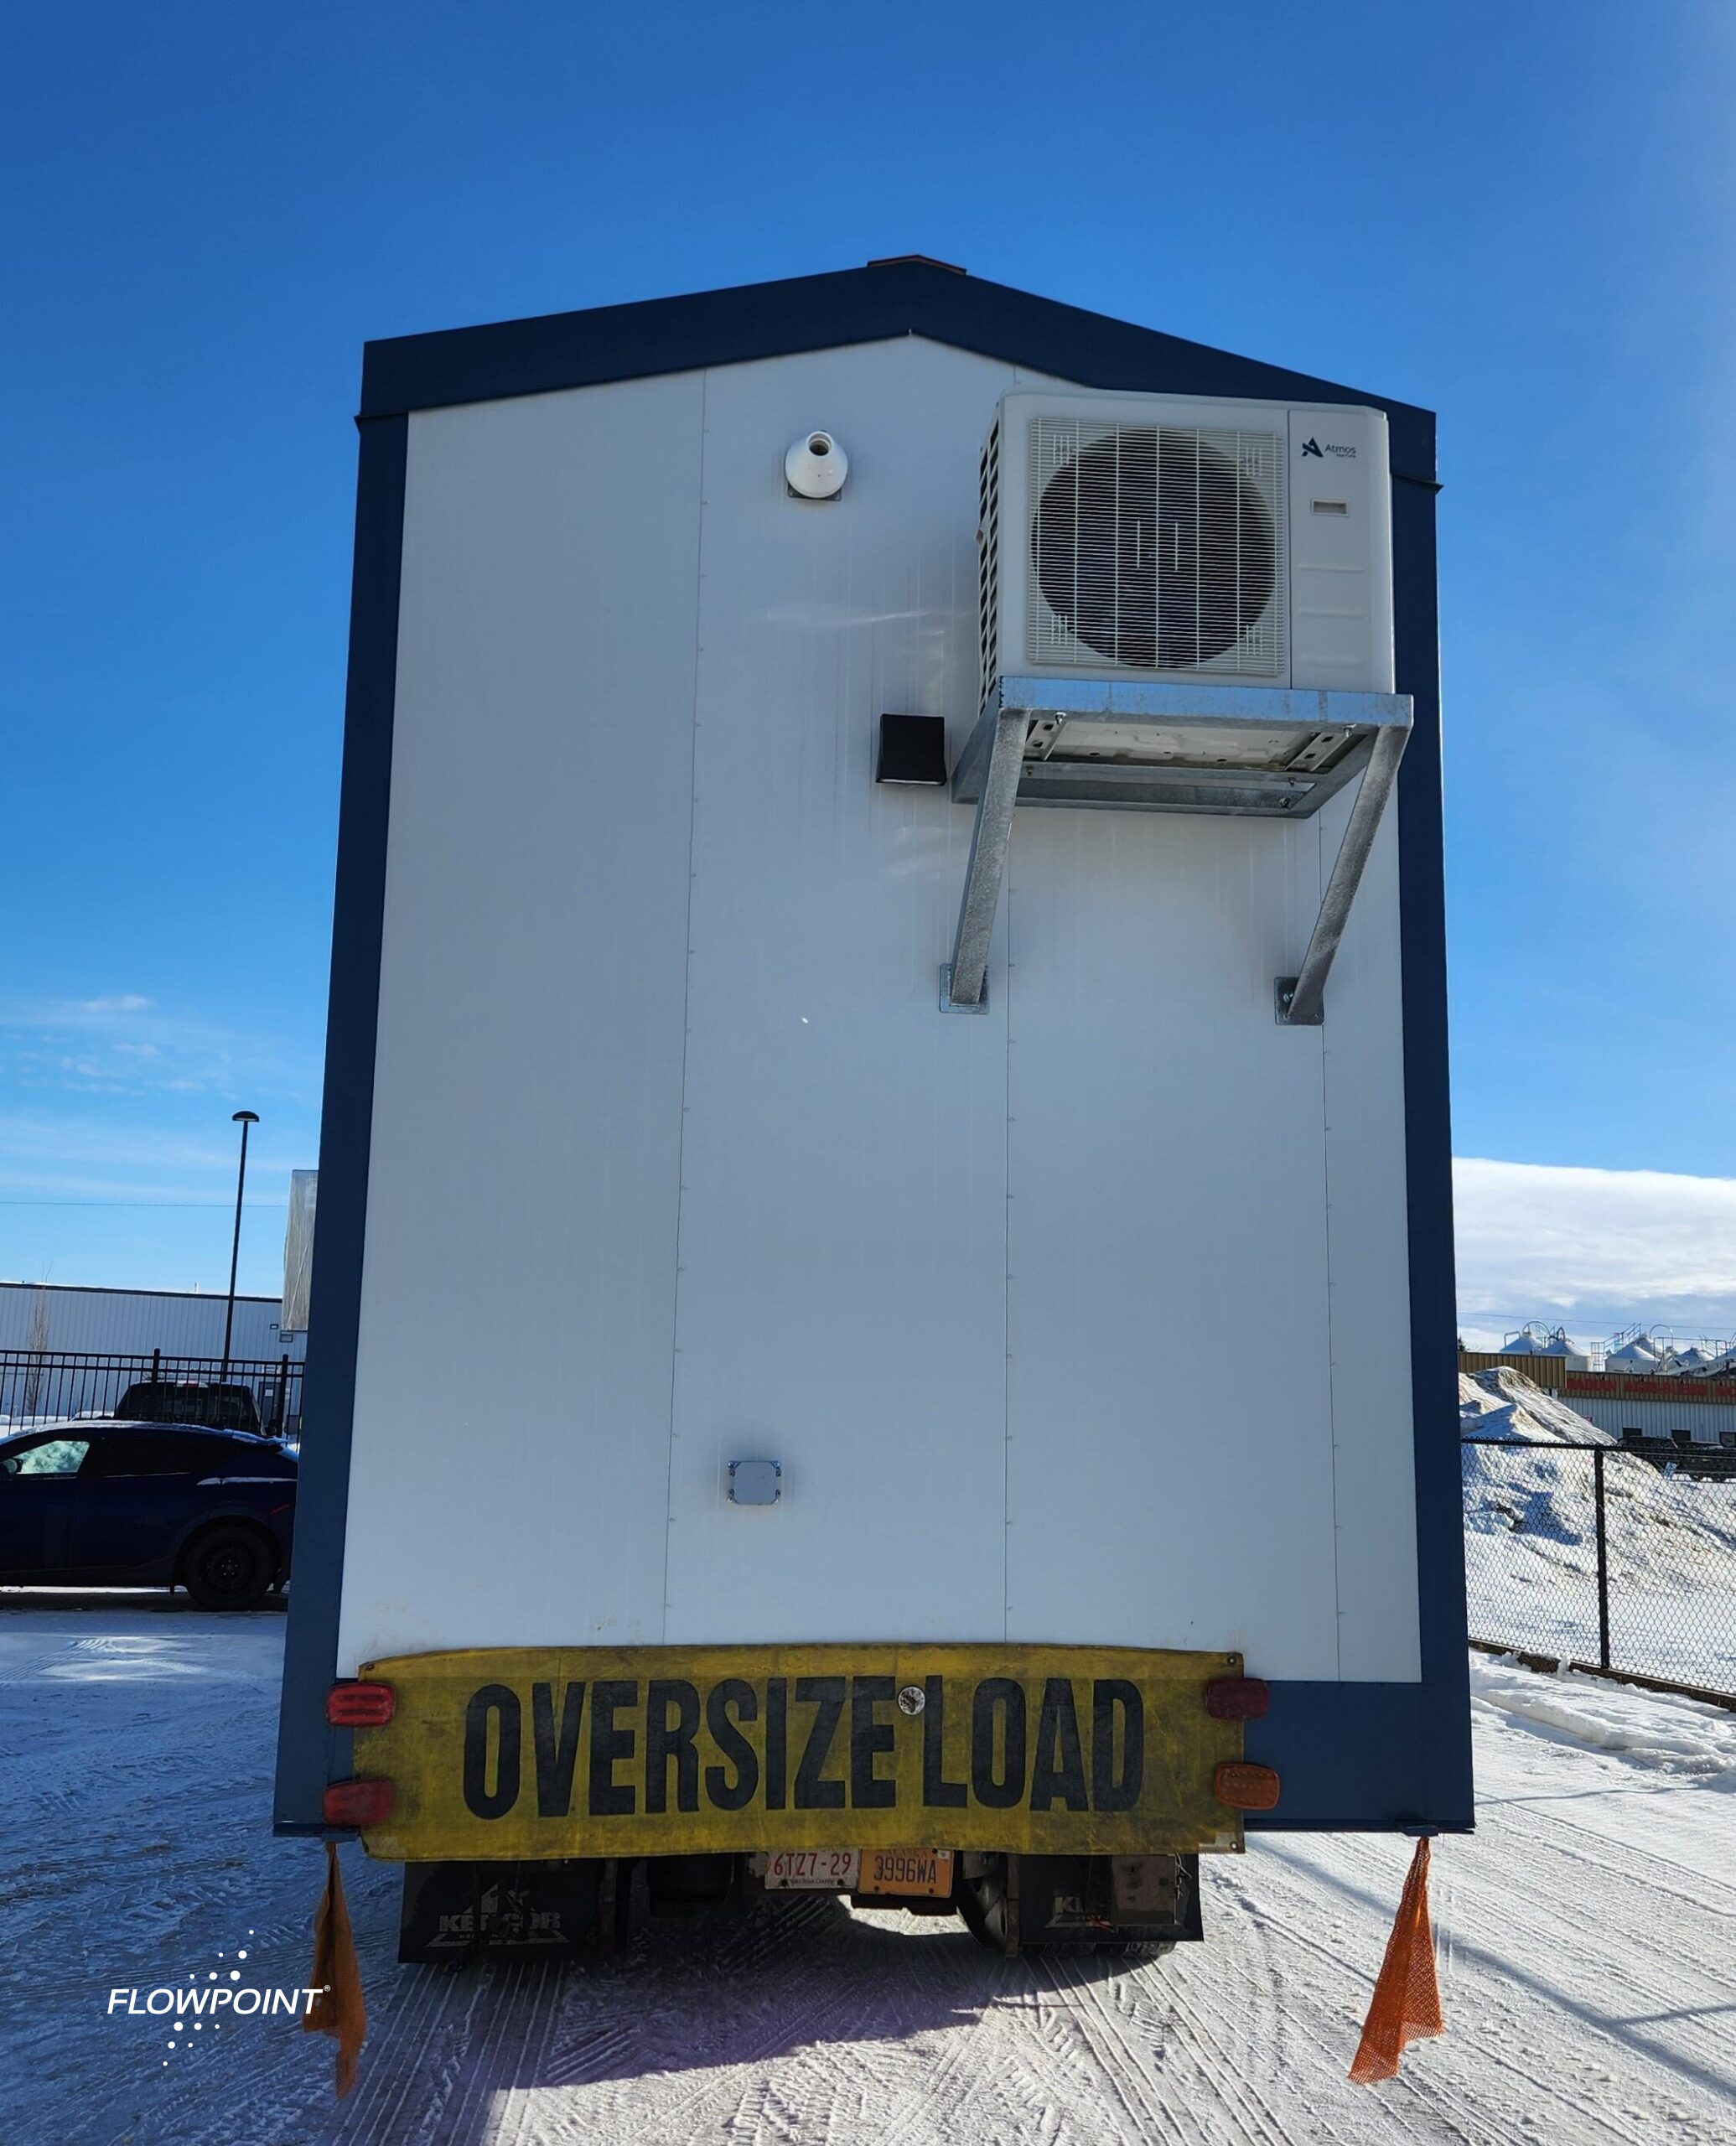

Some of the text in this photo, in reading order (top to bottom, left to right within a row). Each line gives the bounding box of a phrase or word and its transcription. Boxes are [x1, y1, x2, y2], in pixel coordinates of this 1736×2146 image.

[1324, 443, 1356, 454] Atmos
[462, 1675, 1145, 1820] OVERSIZE LOAD
[774, 1853, 852, 1877] 6TZ7-29
[873, 1855, 936, 1884] 3996WA
